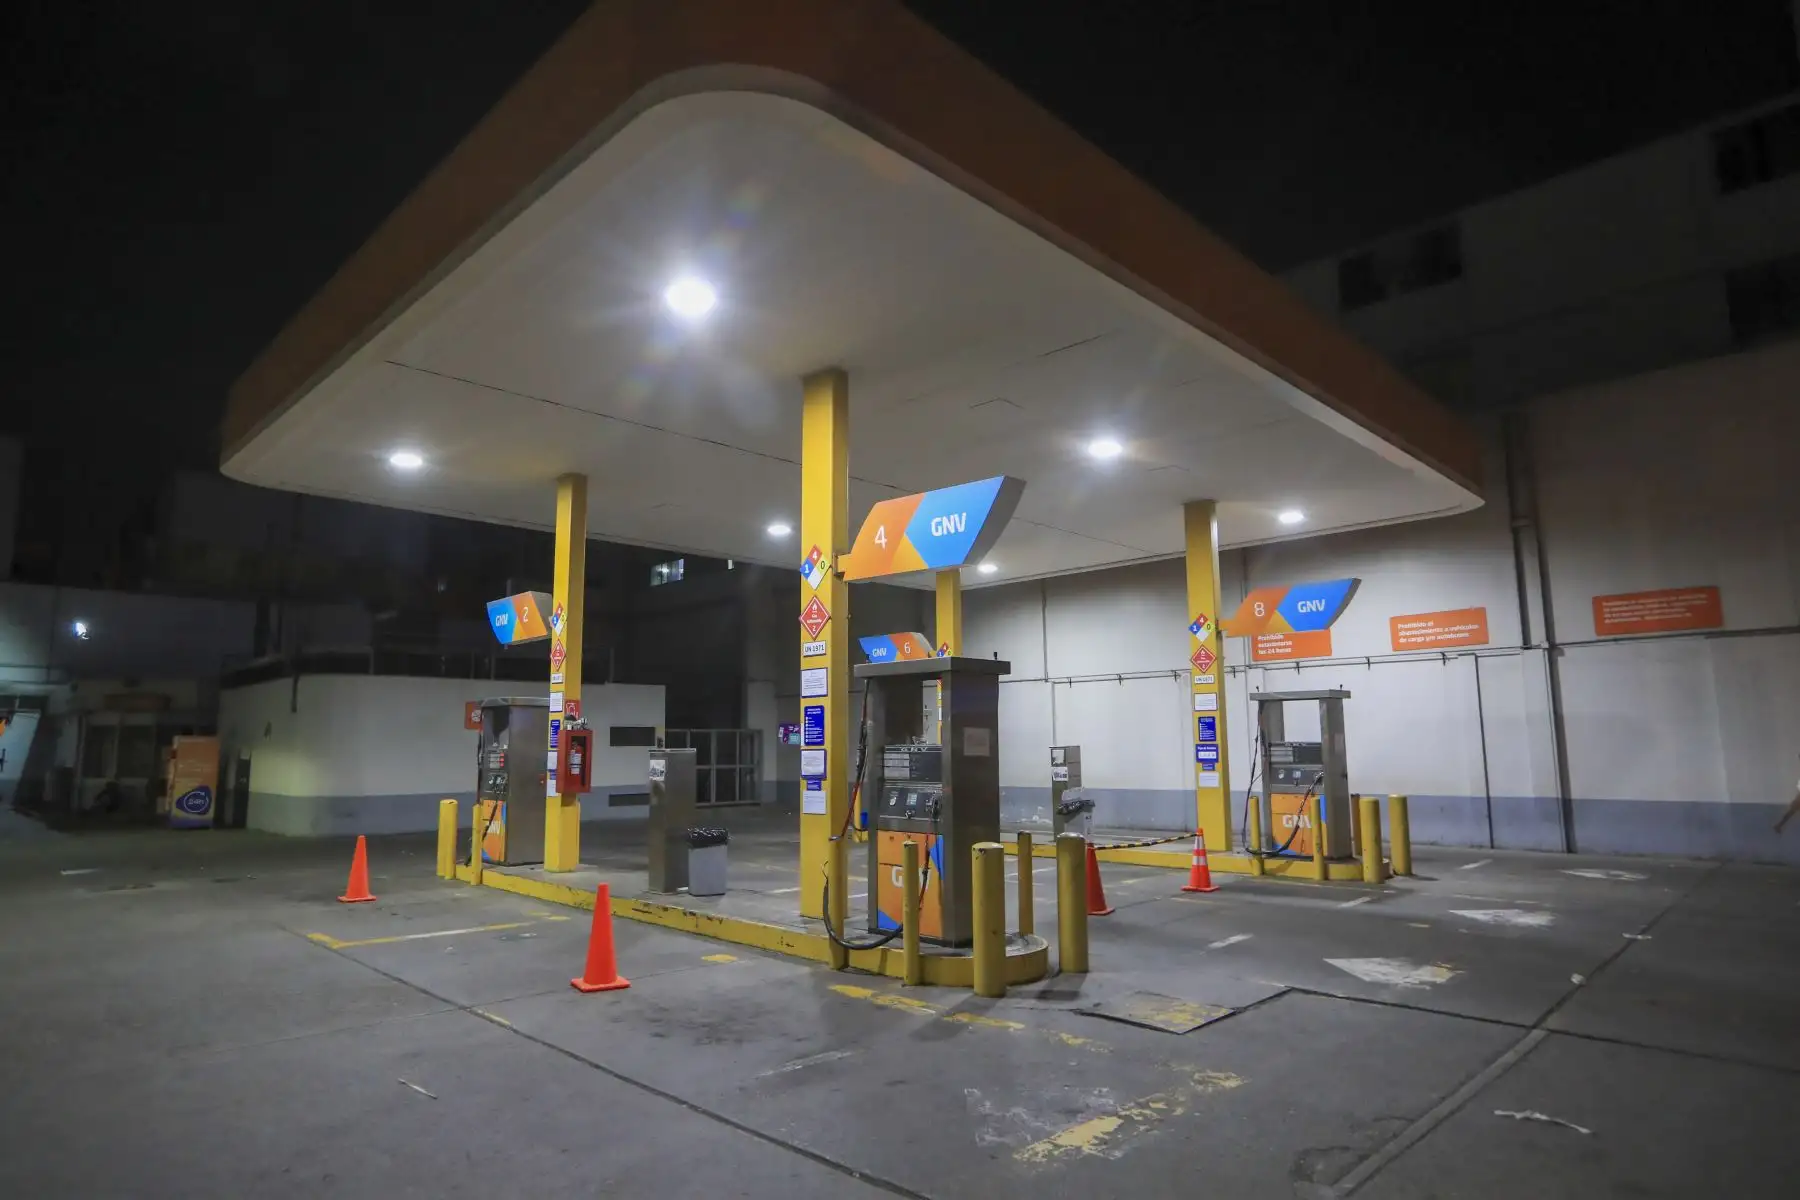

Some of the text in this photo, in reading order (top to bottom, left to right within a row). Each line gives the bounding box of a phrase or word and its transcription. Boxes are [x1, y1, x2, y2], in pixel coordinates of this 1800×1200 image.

[930, 512, 967, 537] GNV
[874, 525, 887, 549] 4
[812, 552, 818, 560] 4
[804, 561, 826, 573] 1 0
[1254, 602, 1264, 617] 8
[1298, 599, 1326, 613] GNV
[496, 613, 509, 627] GNV
[523, 606, 529, 622] 2
[872, 647, 887, 657] GNV
[904, 641, 911, 654] 6
[892, 866, 932, 892] GV
